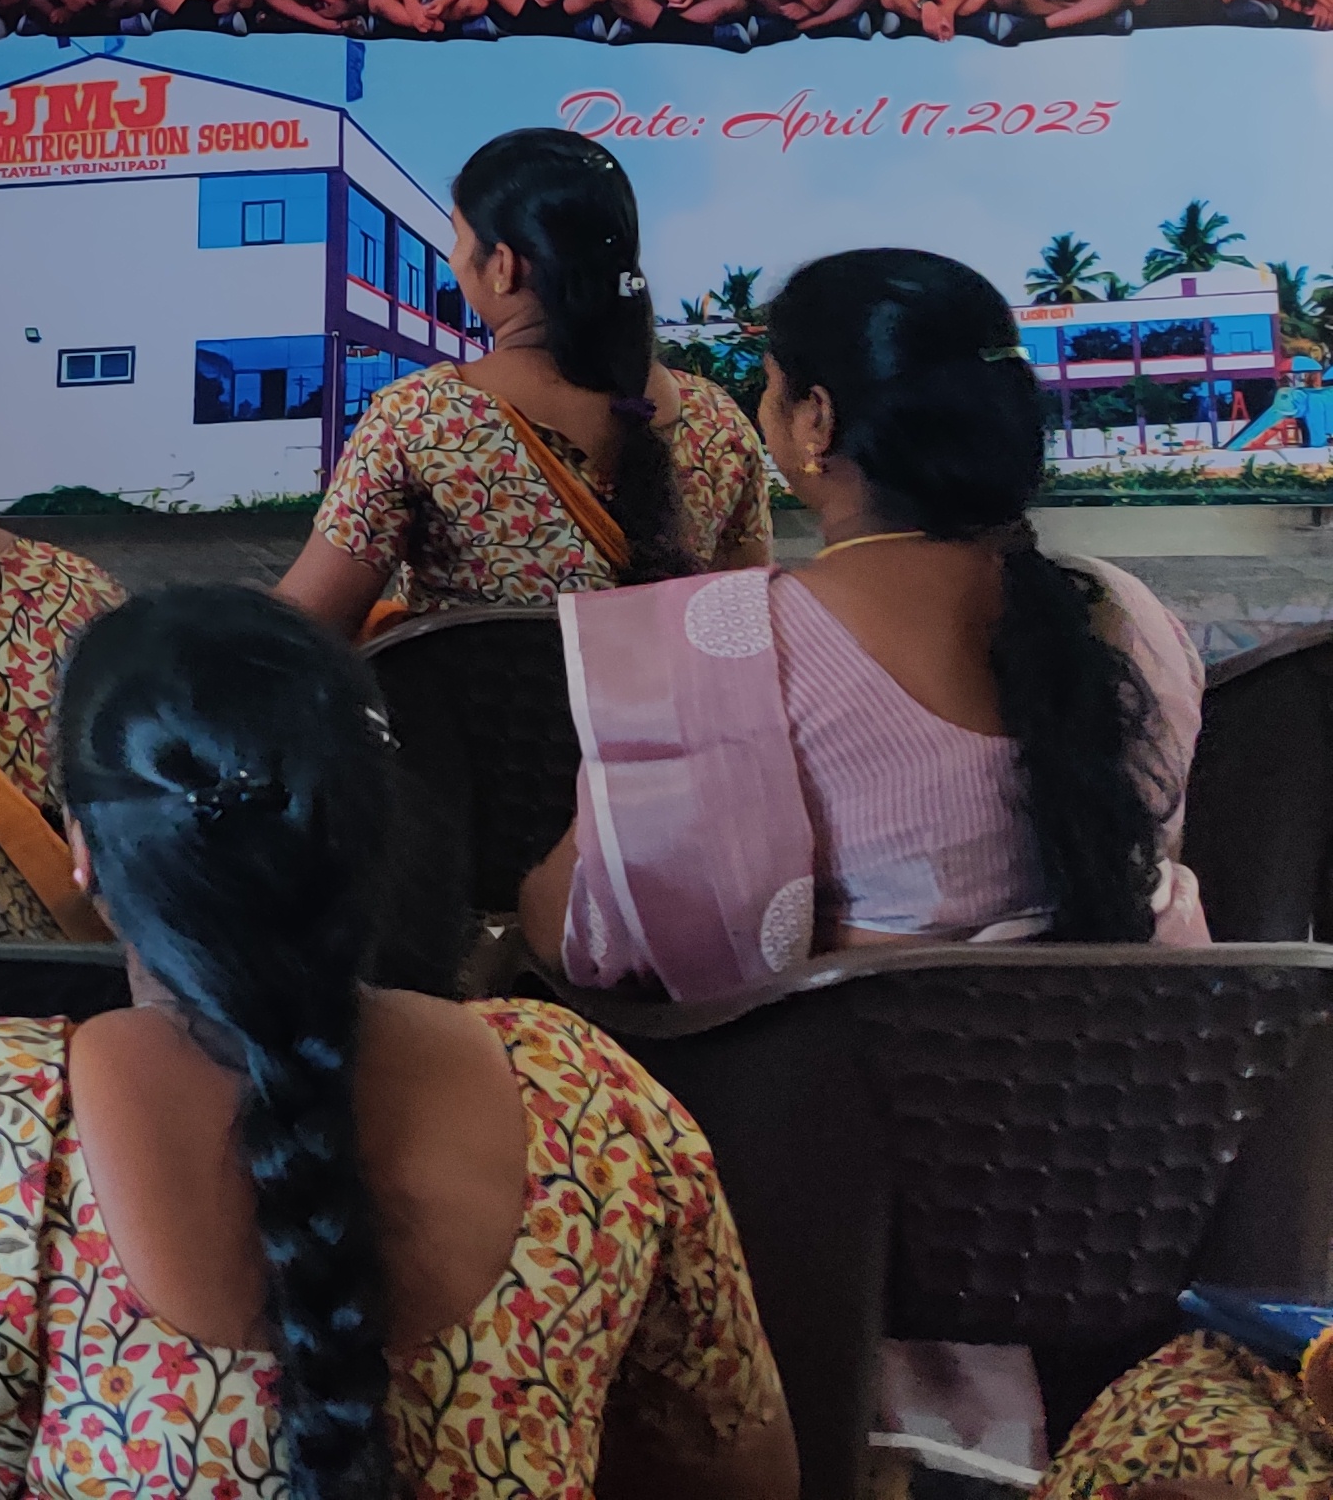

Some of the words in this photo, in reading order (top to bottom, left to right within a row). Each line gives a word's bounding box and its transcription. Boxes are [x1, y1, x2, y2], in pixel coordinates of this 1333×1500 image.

[197, 119, 309, 155] SCHOOL
[561, 91, 706, 139] Date:
[721, 88, 889, 153] April
[900, 100, 1122, 140] 17,2025
[61, 159, 167, 175] KURINJIPADI
